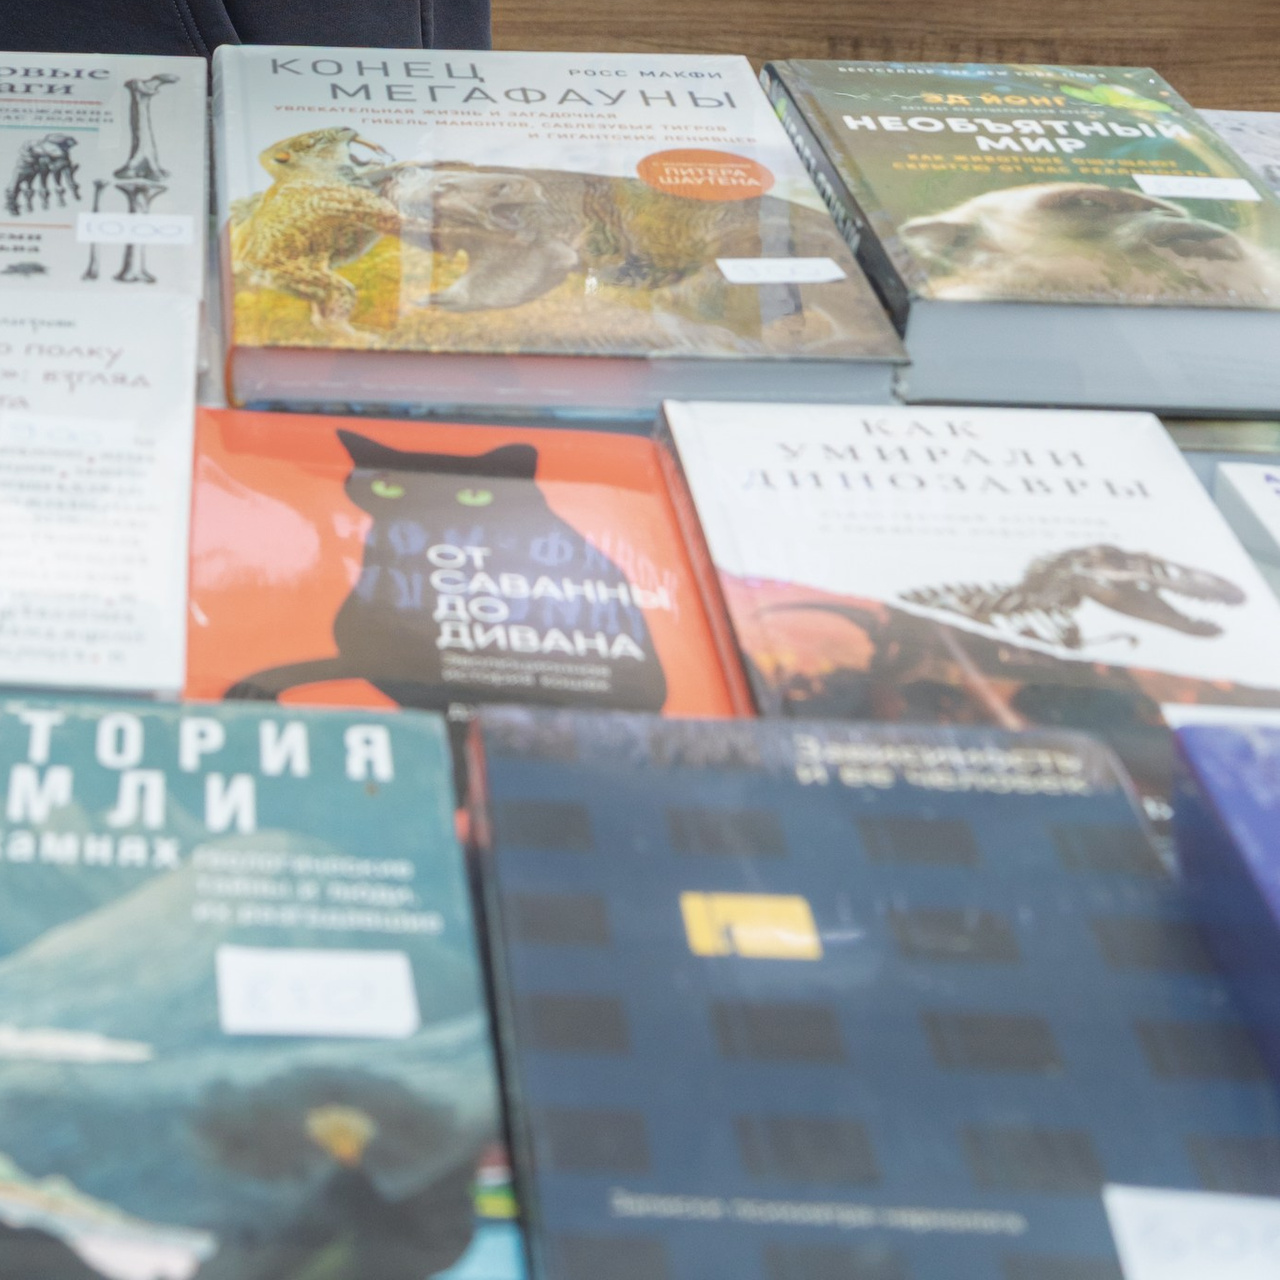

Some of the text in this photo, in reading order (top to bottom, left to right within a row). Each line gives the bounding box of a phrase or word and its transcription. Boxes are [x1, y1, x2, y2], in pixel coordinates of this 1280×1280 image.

[270, 58, 486, 84] КОНЕЦ
[569, 69, 723, 80] РОСС МАКФИ
[329, 82, 738, 111] МЕГАФАУНЫ
[921, 91, 971, 108] ЭД
[273, 104, 415, 115] УВЛЕКАТЕЛЬНАЯ
[508, 110, 618, 120] ЗАГАДОЧНАЯ
[360, 117, 429, 127] ГИБЕЛЬ
[660, 123, 728, 133] ТИГРОВ
[841, 114, 1194, 140] НЕОБЪЯТНЫЙ
[974, 134, 1087, 154] МИР
[658, 175, 762, 188] ШАУТЕНА
[664, 167, 748, 179] ПИТЕРА
[861, 418, 980, 439] КАК
[776, 441, 1088, 469] УМИРАЛИ
[742, 468, 1151, 500] ДИНОЗАВРЫ
[426, 544, 492, 570] ОТ
[429, 568, 671, 612] САВАННЫ
[432, 594, 510, 624] ДО
[435, 620, 647, 662] ДИВАНА
